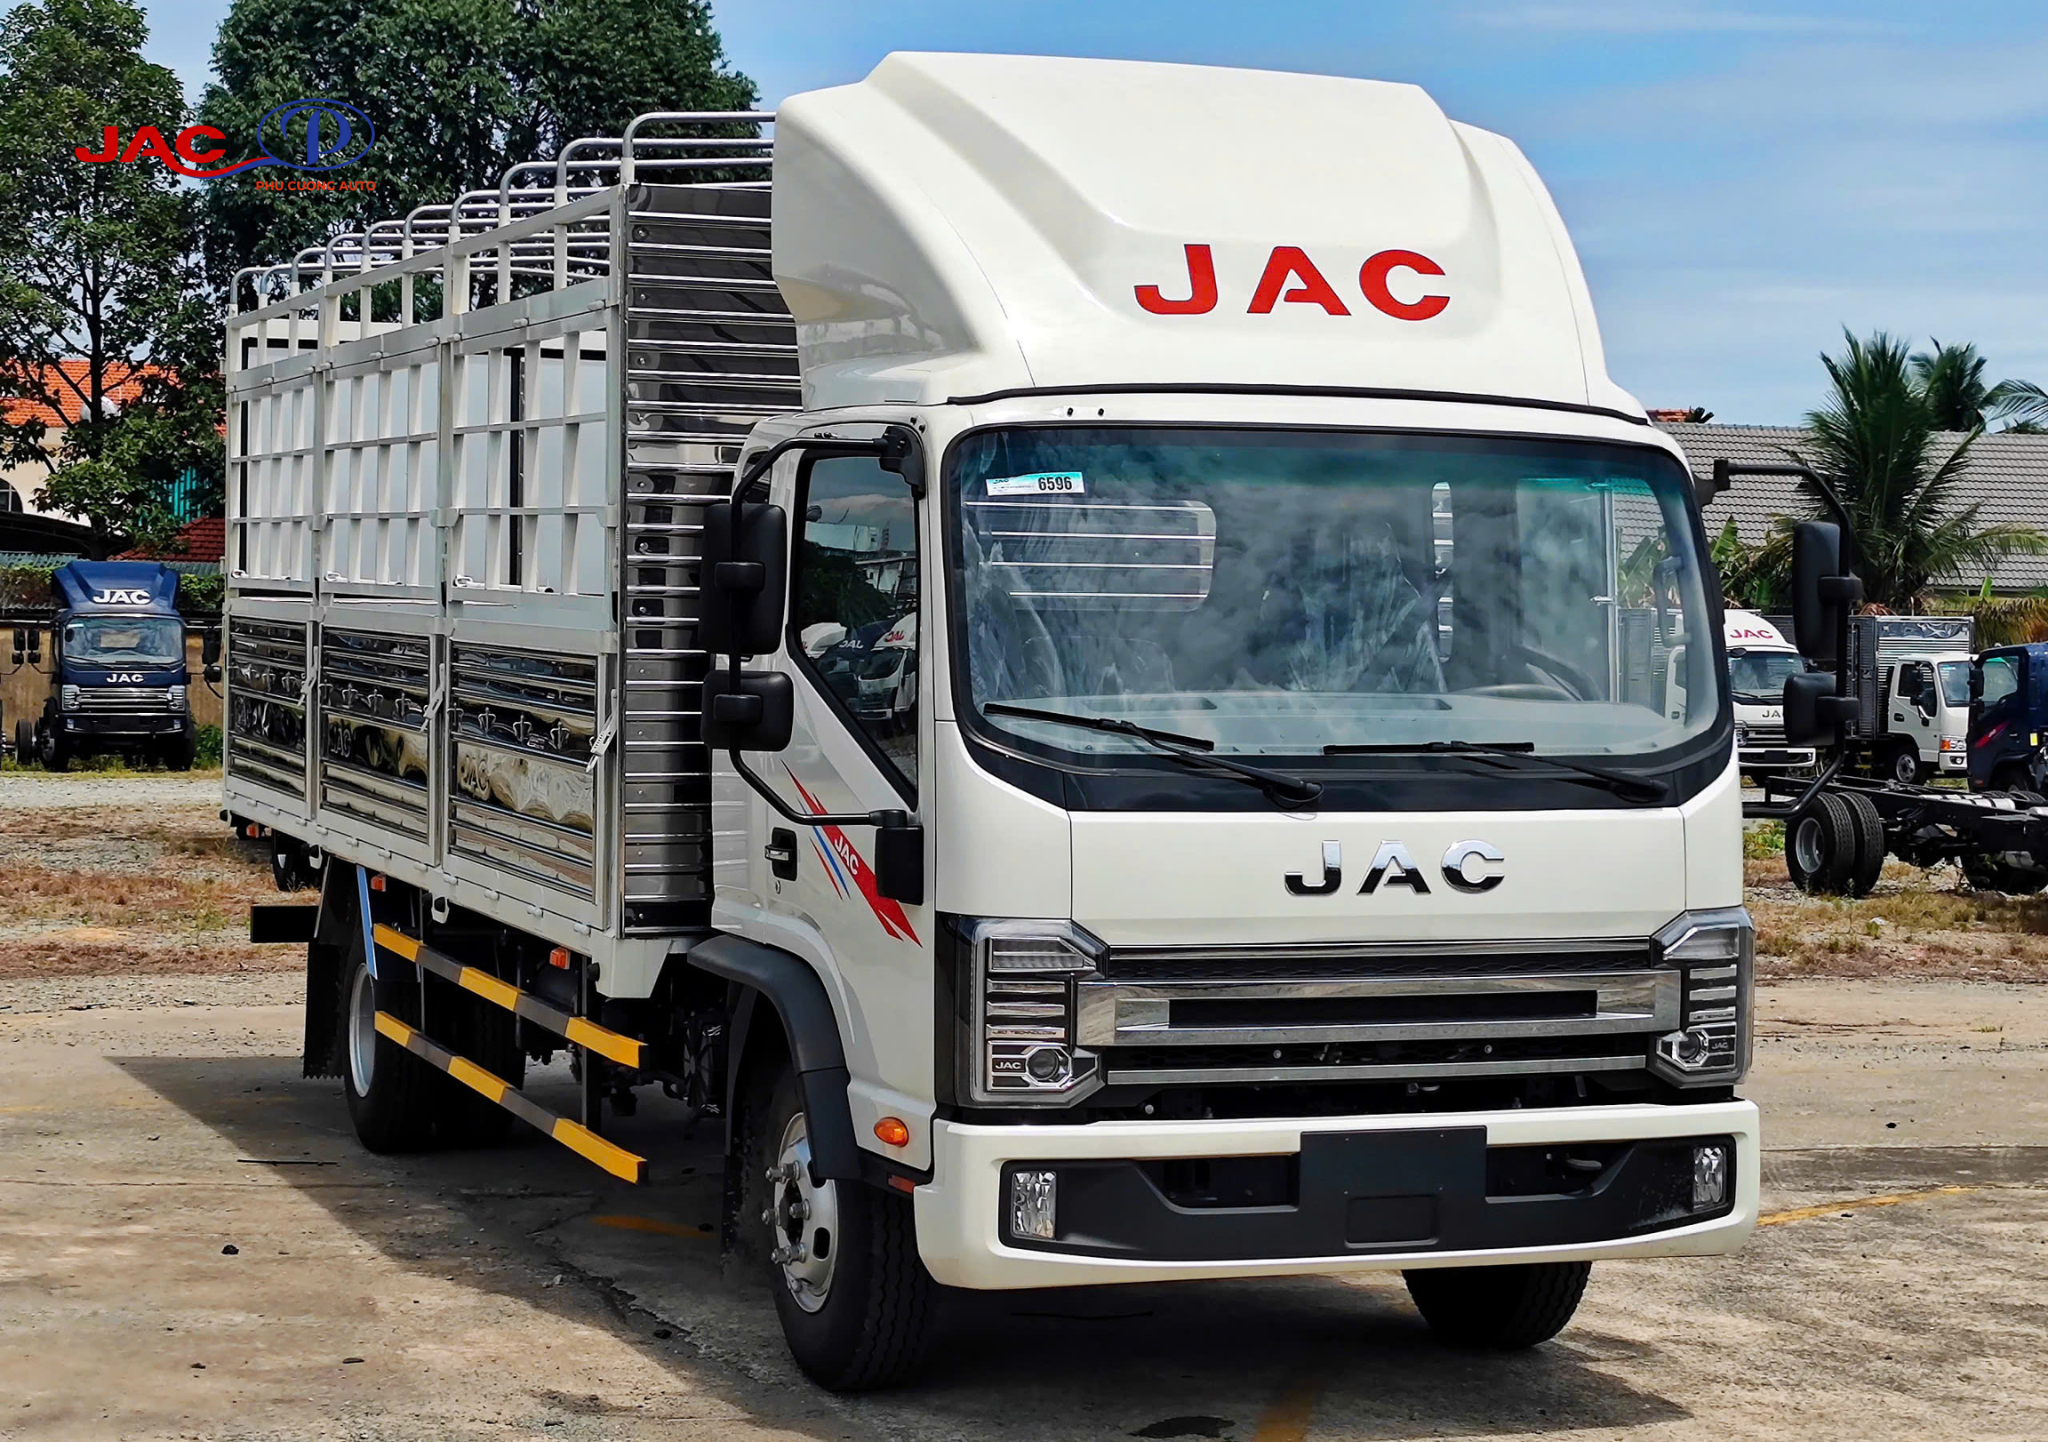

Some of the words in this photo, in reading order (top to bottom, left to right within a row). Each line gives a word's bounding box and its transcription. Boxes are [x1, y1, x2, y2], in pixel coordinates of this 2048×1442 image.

[1134, 243, 1451, 321] JAC
[1038, 476, 1073, 491] 6596
[92, 589, 151, 605] JAC
[1730, 629, 1773, 639] JAC
[106, 673, 145, 684] JAC
[1761, 709, 1782, 718] JA
[834, 834, 860, 875] JAC
[1284, 839, 1505, 896] JAC
[995, 1061, 1021, 1070] JAC
